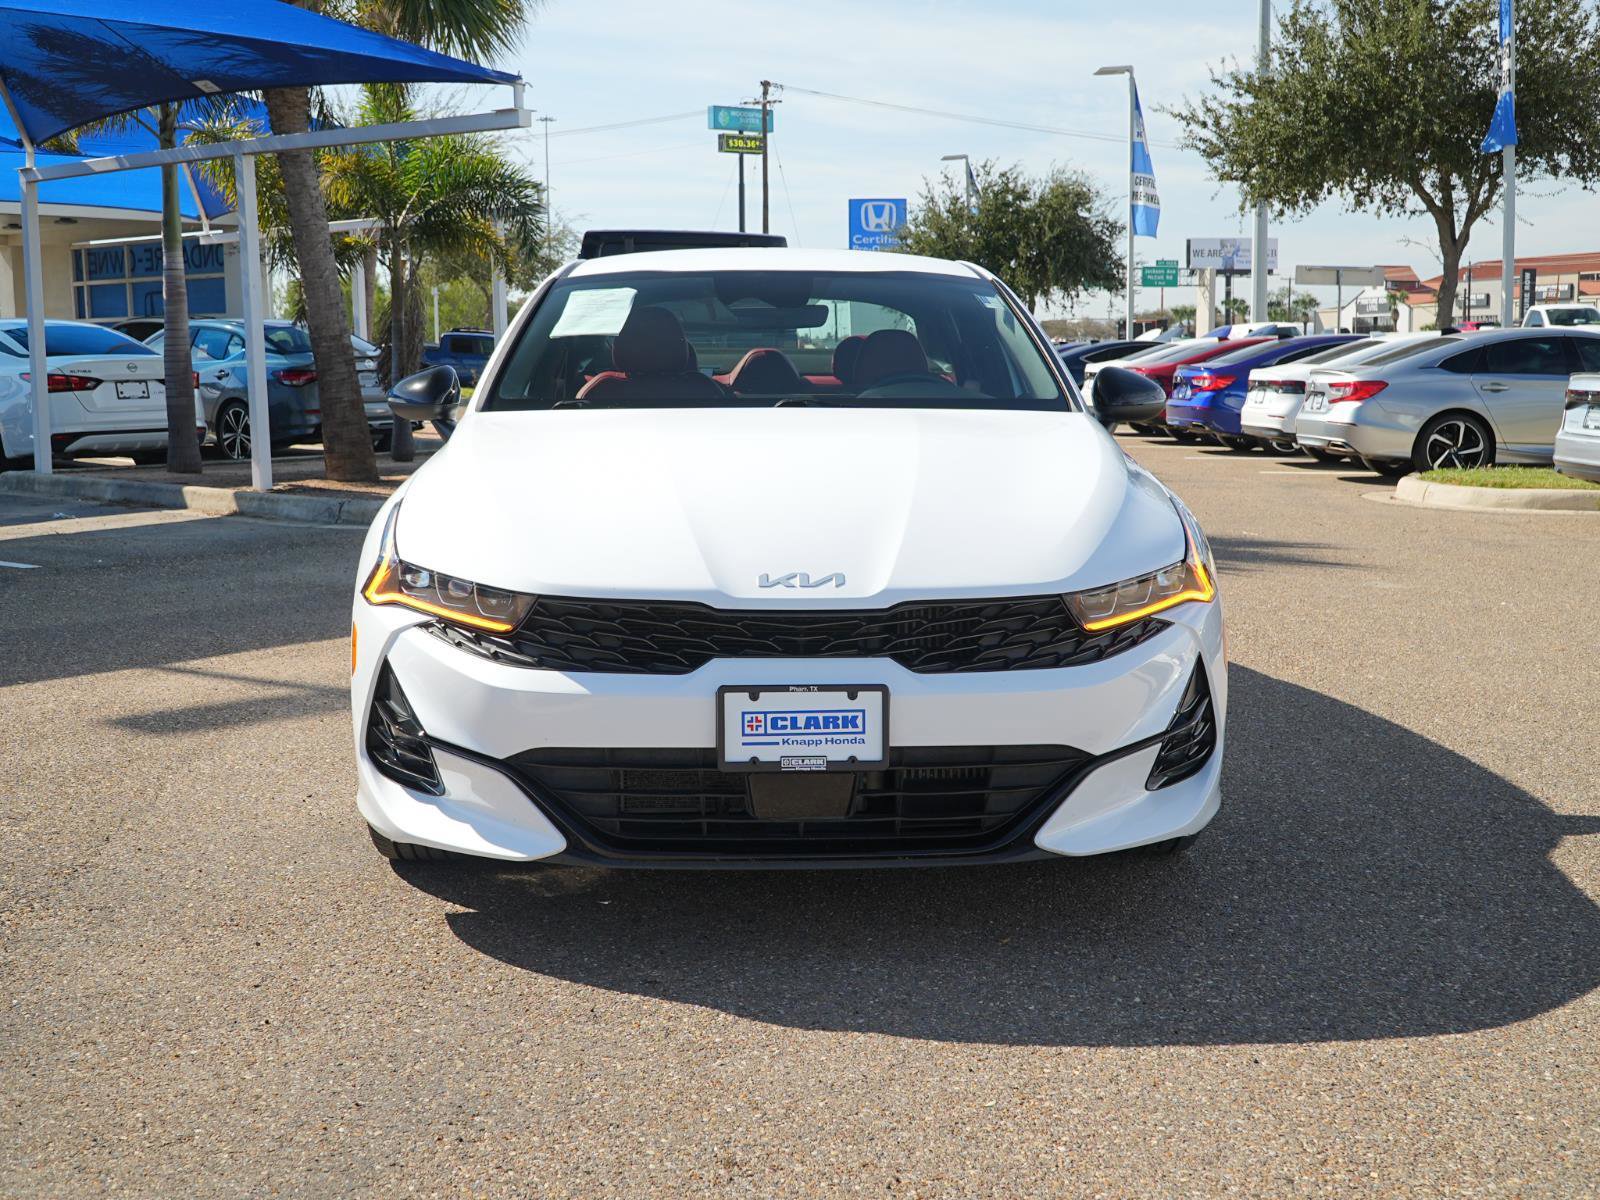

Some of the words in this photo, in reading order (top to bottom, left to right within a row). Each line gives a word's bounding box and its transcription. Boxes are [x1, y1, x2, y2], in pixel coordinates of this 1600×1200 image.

[770, 714, 860, 731] CLARK
[781, 737, 823, 747] Knapp
[825, 736, 866, 746] Honda
[791, 758, 825, 766] CLARK
